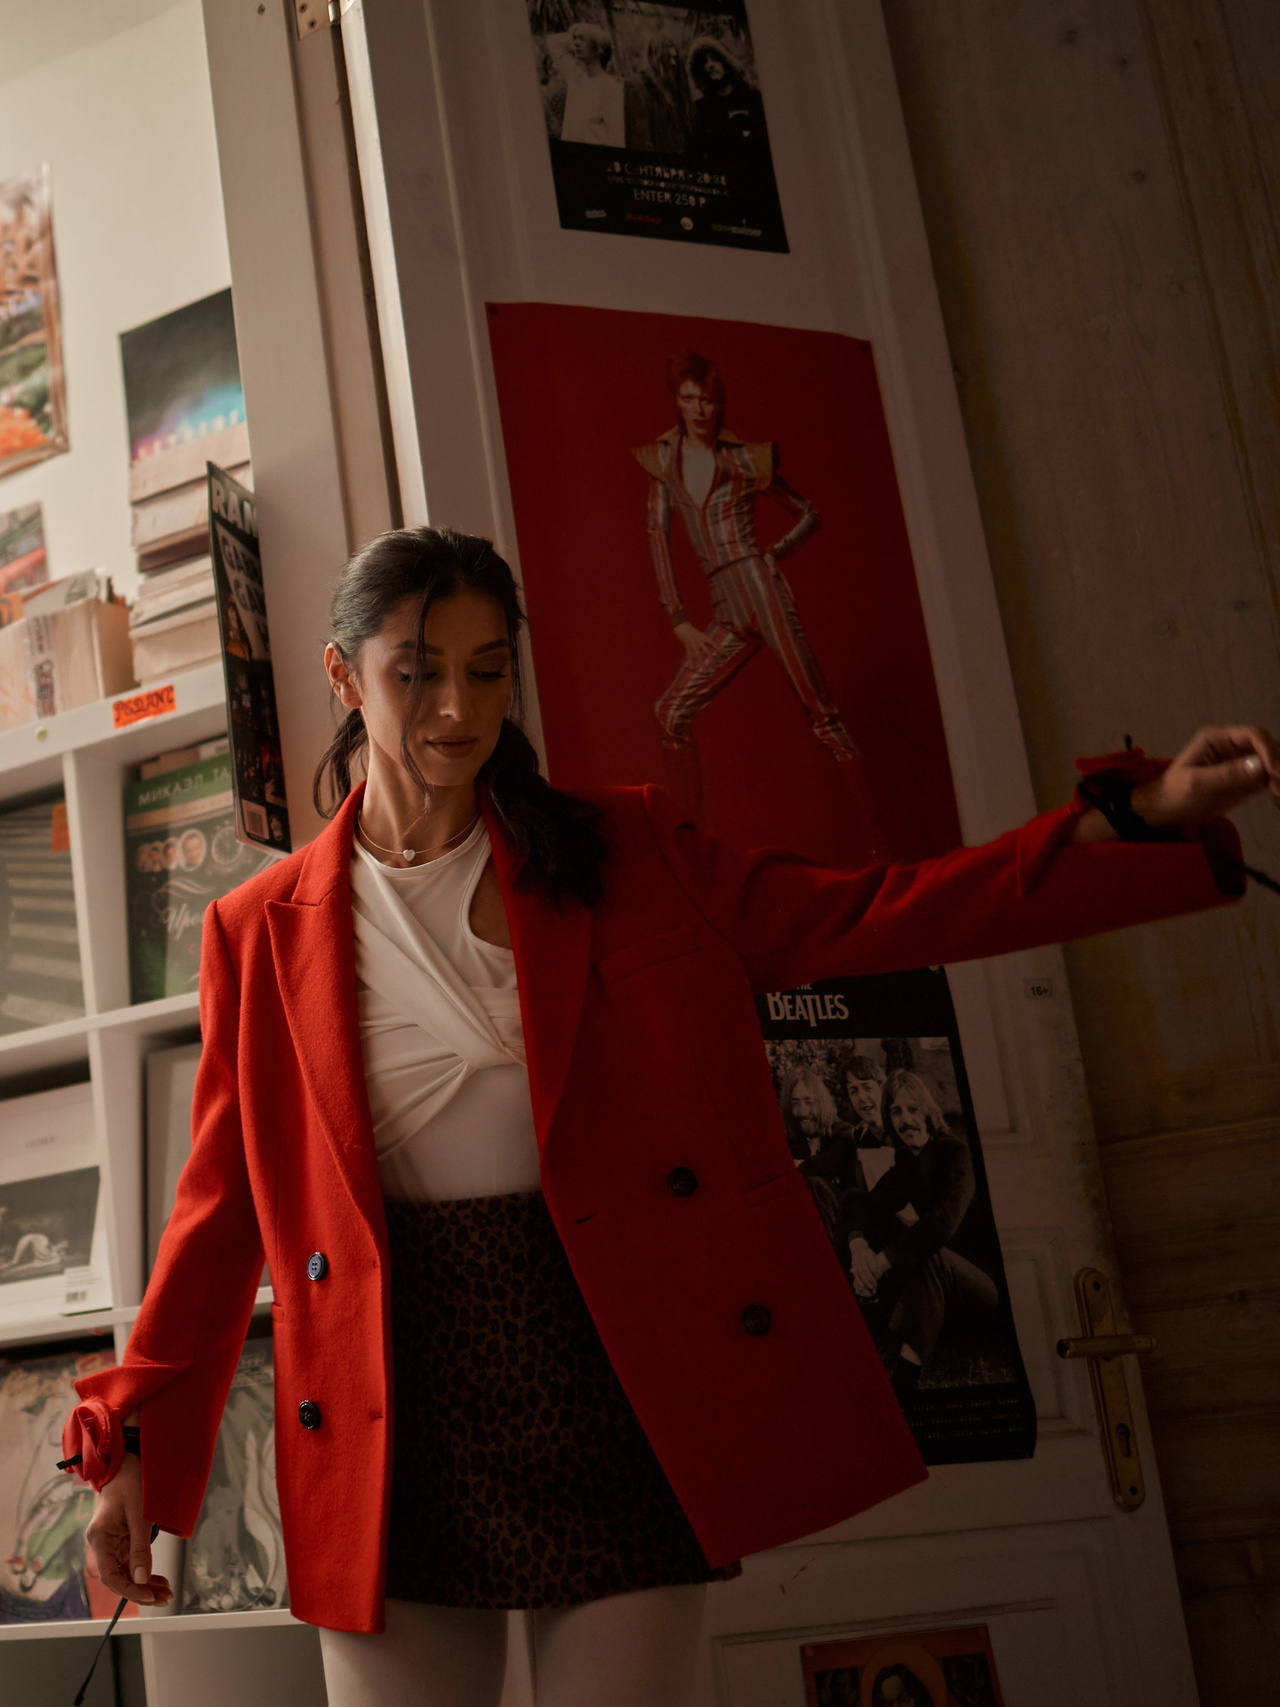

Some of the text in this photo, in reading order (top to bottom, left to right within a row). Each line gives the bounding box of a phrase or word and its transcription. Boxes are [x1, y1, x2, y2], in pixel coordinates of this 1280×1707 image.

[633, 188, 672, 204] ENTER
[675, 193, 696, 207] 250
[1030, 985, 1049, 998] 16+
[766, 992, 849, 1028] BEATLES
